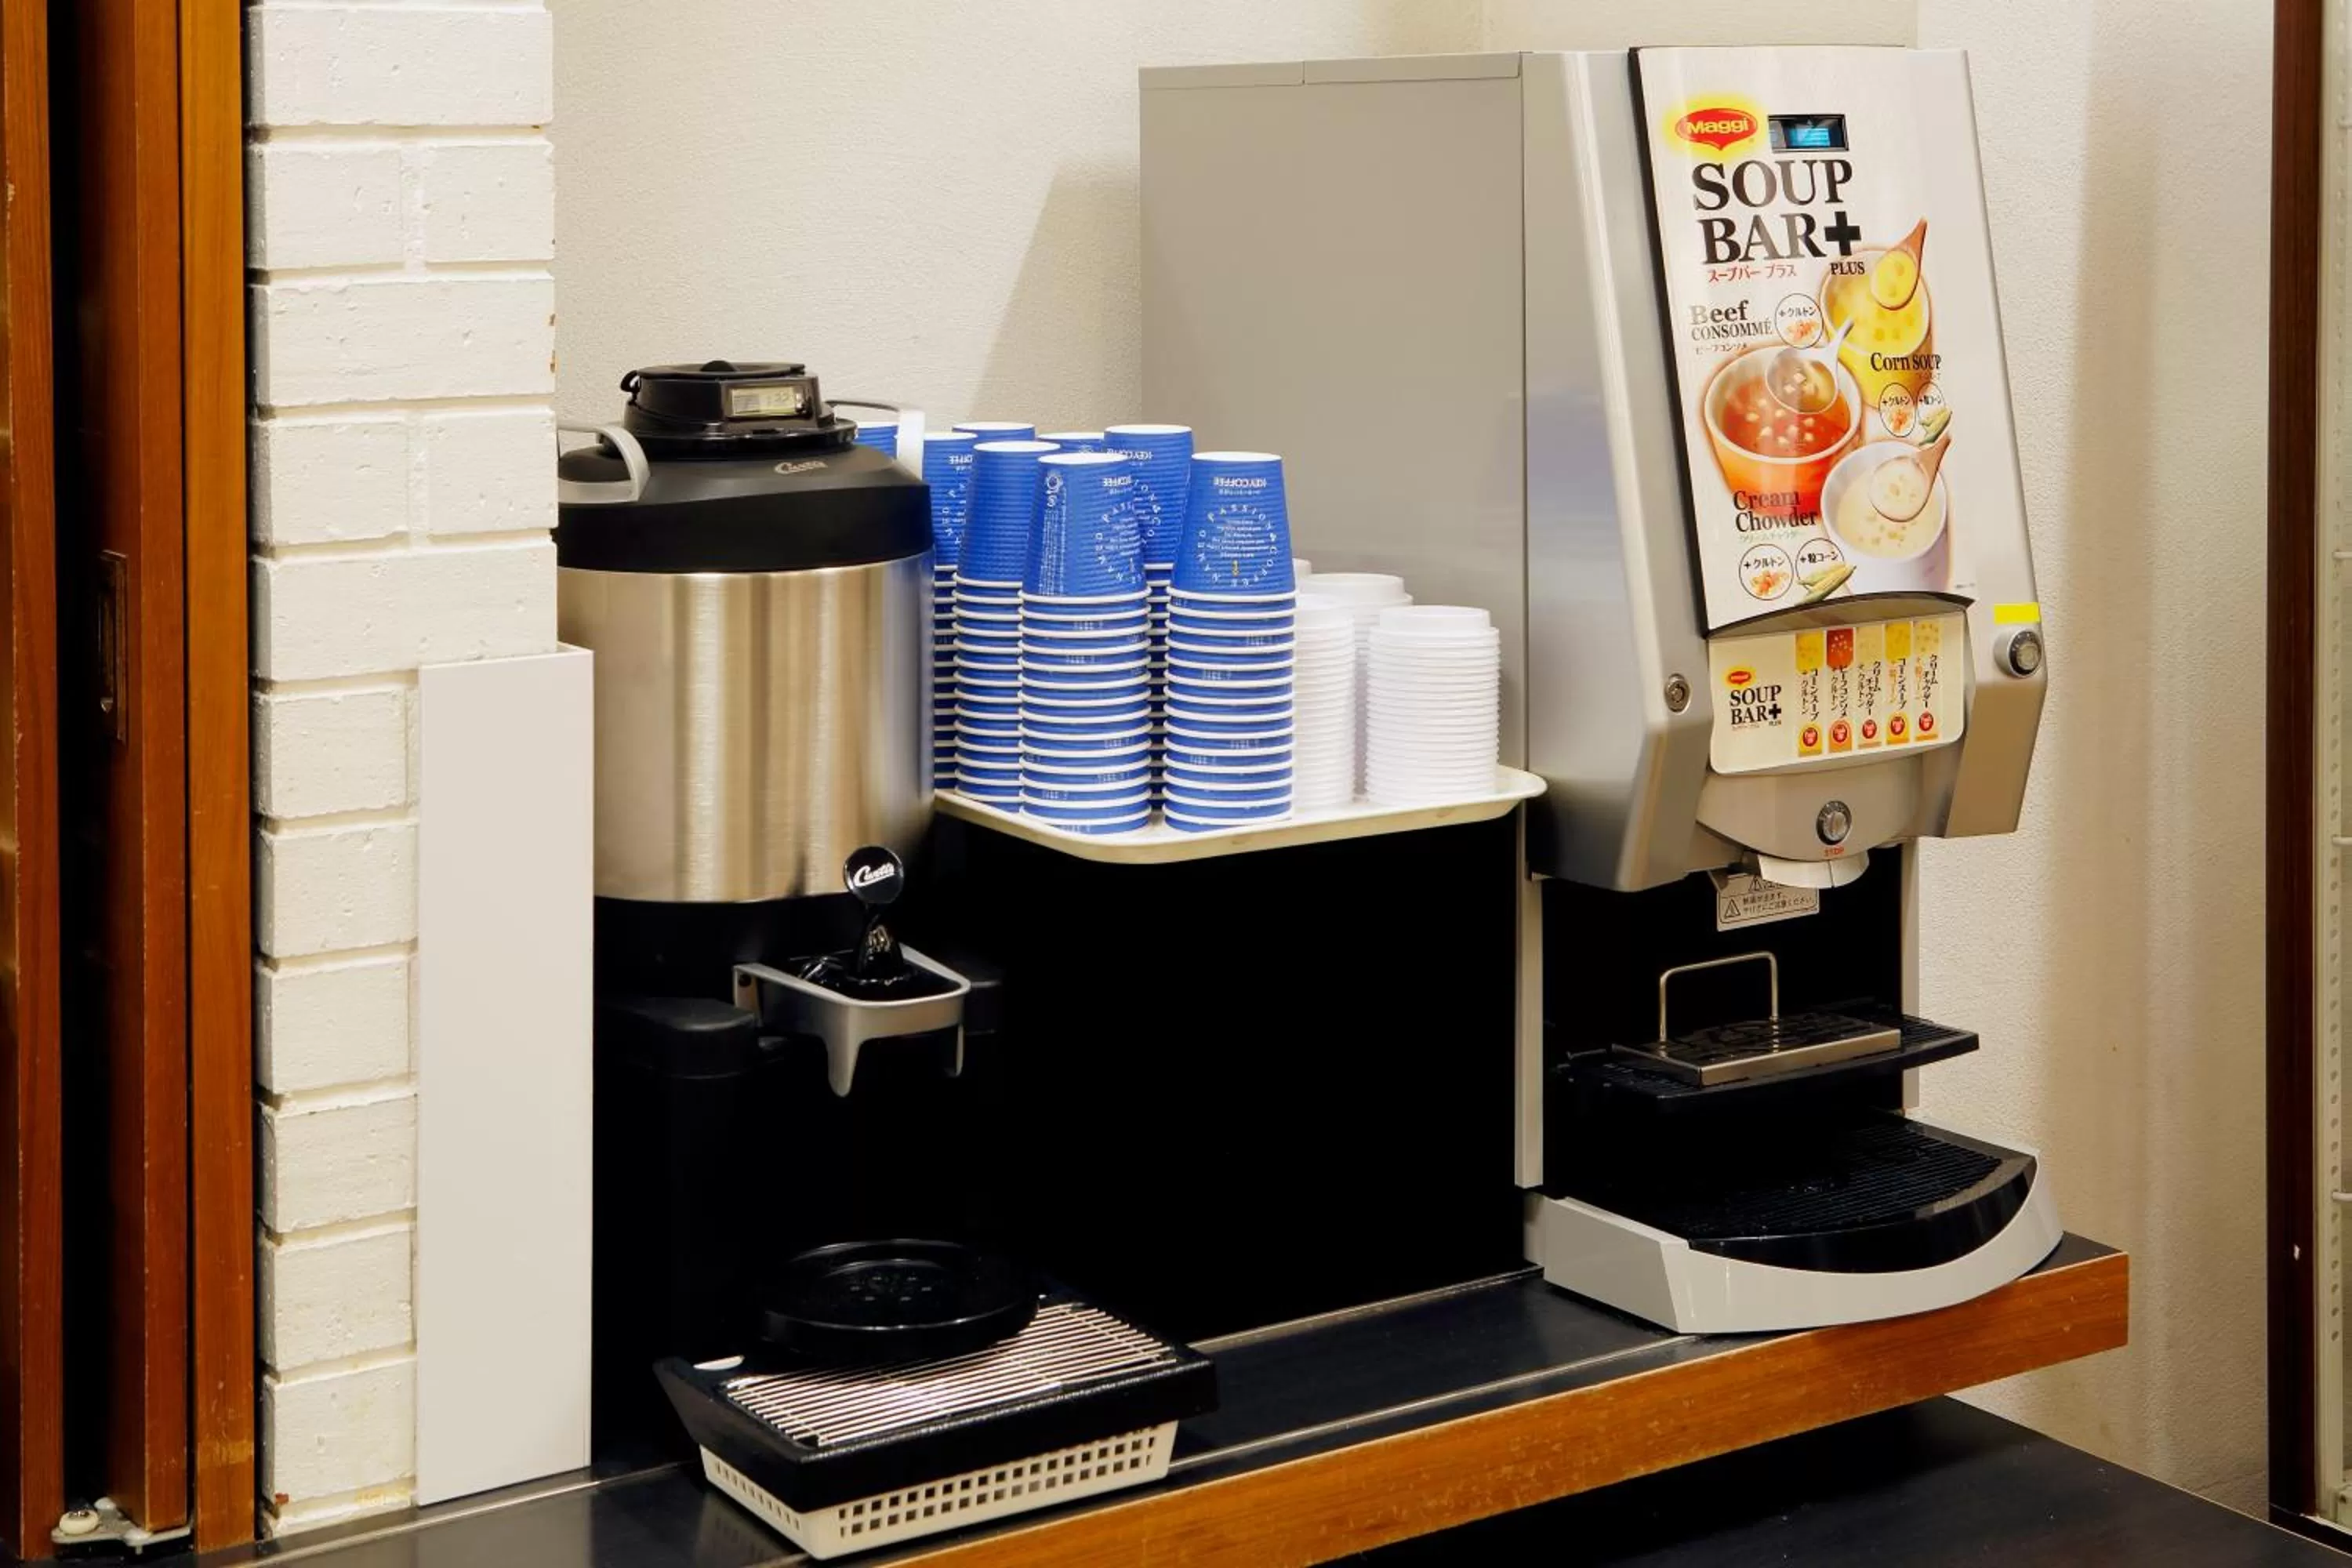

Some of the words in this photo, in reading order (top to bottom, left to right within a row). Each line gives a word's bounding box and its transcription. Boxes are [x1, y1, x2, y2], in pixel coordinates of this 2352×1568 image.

[1686, 118, 1749, 134] Maggi
[1692, 159, 1853, 211] SOUP
[1708, 265, 1761, 283] スープバー
[1766, 264, 1797, 278] プラス
[1830, 260, 1865, 275] PLUS
[1690, 299, 1749, 325] Beef
[1691, 318, 1773, 341] CONSOMMÉ
[1870, 352, 1910, 372] Corn
[1913, 354, 1942, 371] SOUP
[1733, 490, 1801, 510] Cream
[1735, 506, 1818, 532] Chowder
[1730, 685, 1782, 707] SOUP
